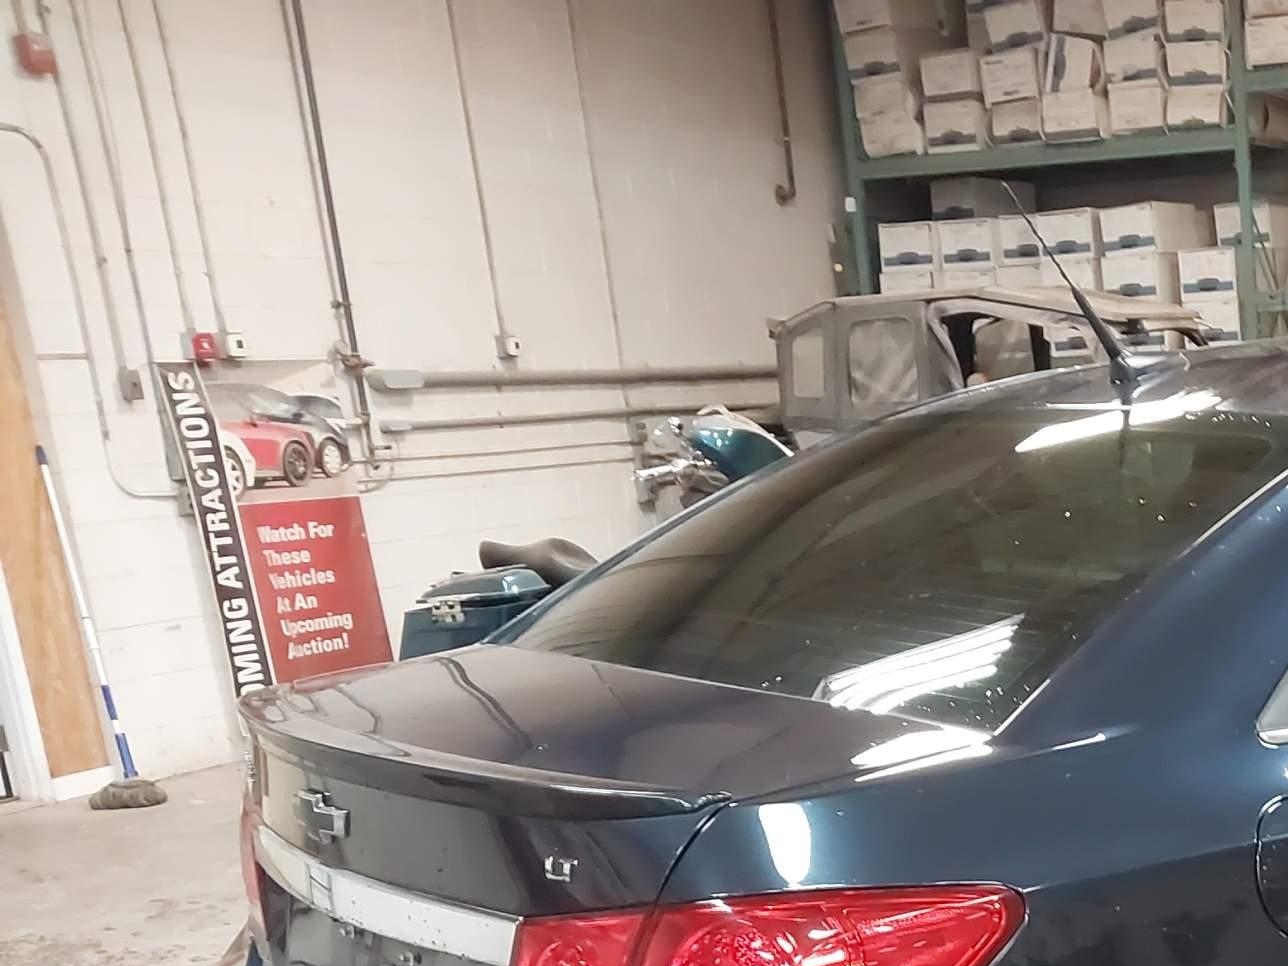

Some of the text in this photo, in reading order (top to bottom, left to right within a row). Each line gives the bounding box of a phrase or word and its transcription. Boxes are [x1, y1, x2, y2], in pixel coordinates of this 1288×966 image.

[167, 371, 243, 589] ATTRACTIONS
[256, 521, 334, 543] Watch For
[262, 550, 311, 567] These
[269, 568, 336, 590] Vehicles
[277, 592, 318, 614] At An
[280, 612, 353, 638] Upcoming
[288, 632, 349, 660] Auction!
[544, 856, 578, 882] LT
